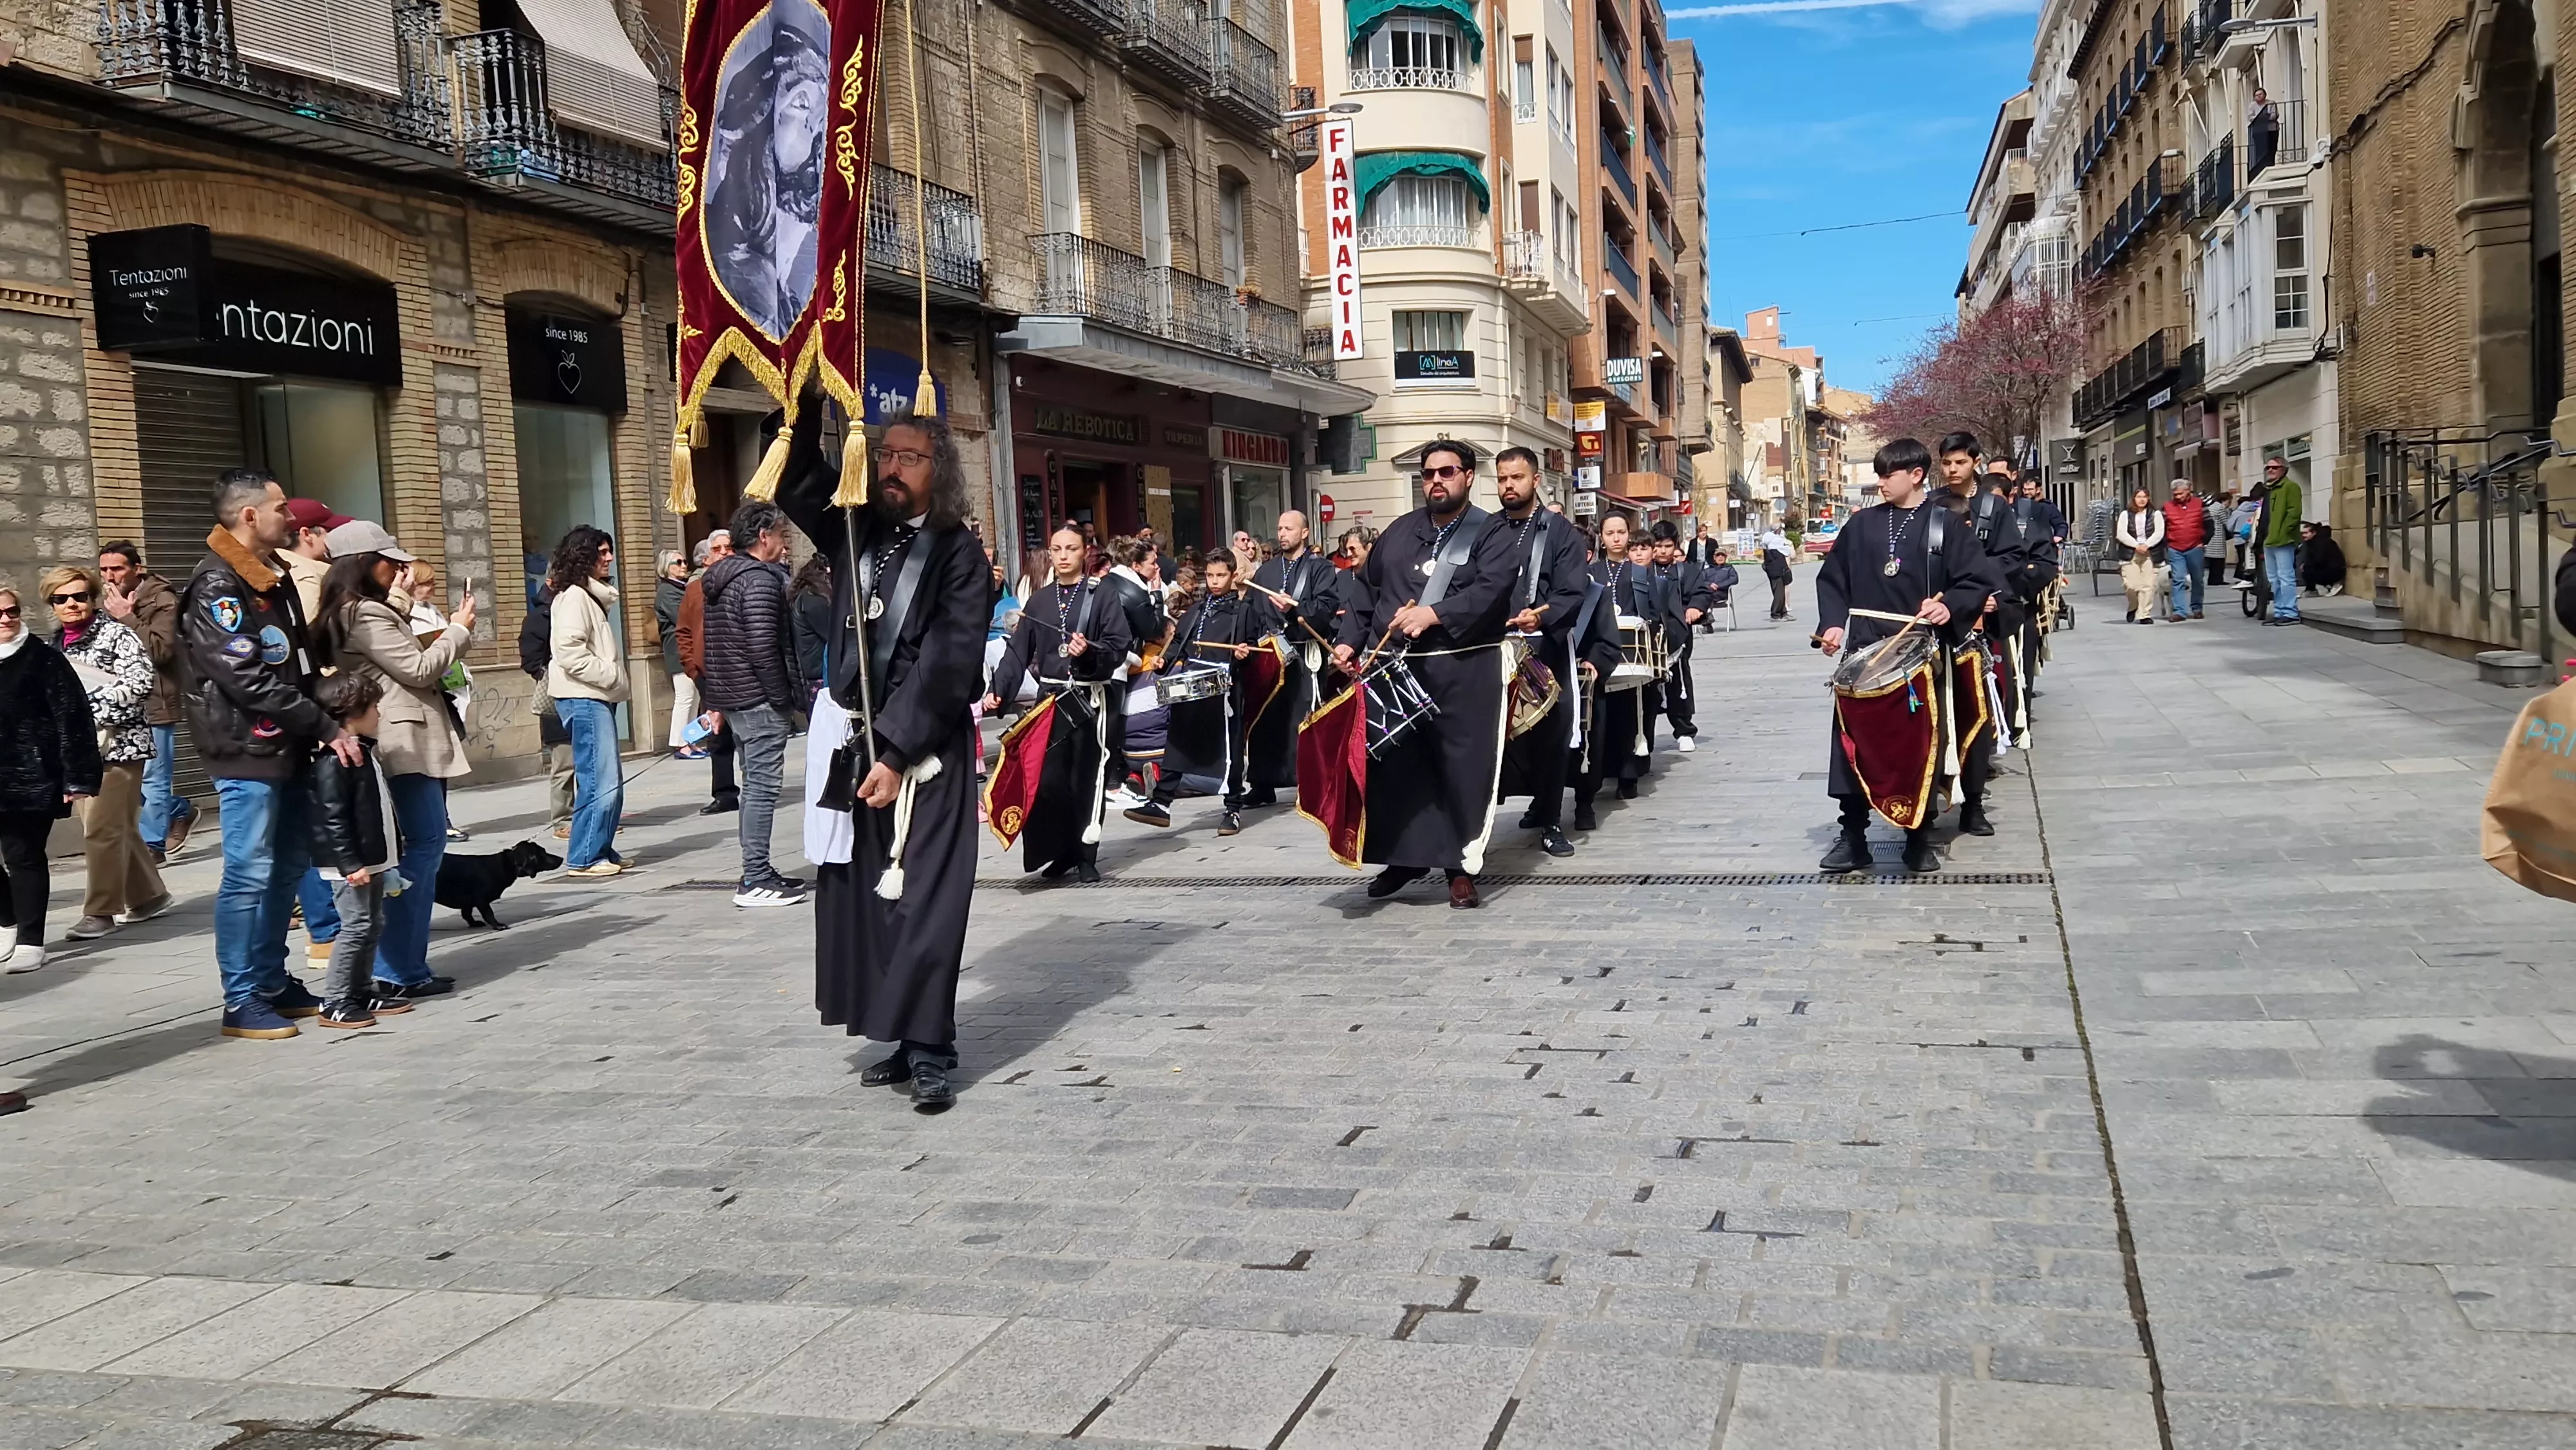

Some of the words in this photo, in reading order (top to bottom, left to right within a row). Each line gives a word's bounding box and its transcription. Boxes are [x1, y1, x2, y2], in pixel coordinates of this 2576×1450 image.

[1329, 128, 1356, 353] FARMACIA
[109, 267, 187, 286] Tentazioni
[129, 290, 148, 299] since
[216, 299, 374, 355] ntazioni
[545, 326, 567, 340] since
[569, 330, 587, 343] 1985
[1607, 358, 1642, 377] DUVISA
[1036, 410, 1058, 430] LA
[1062, 413, 1135, 441] REBOTICA
